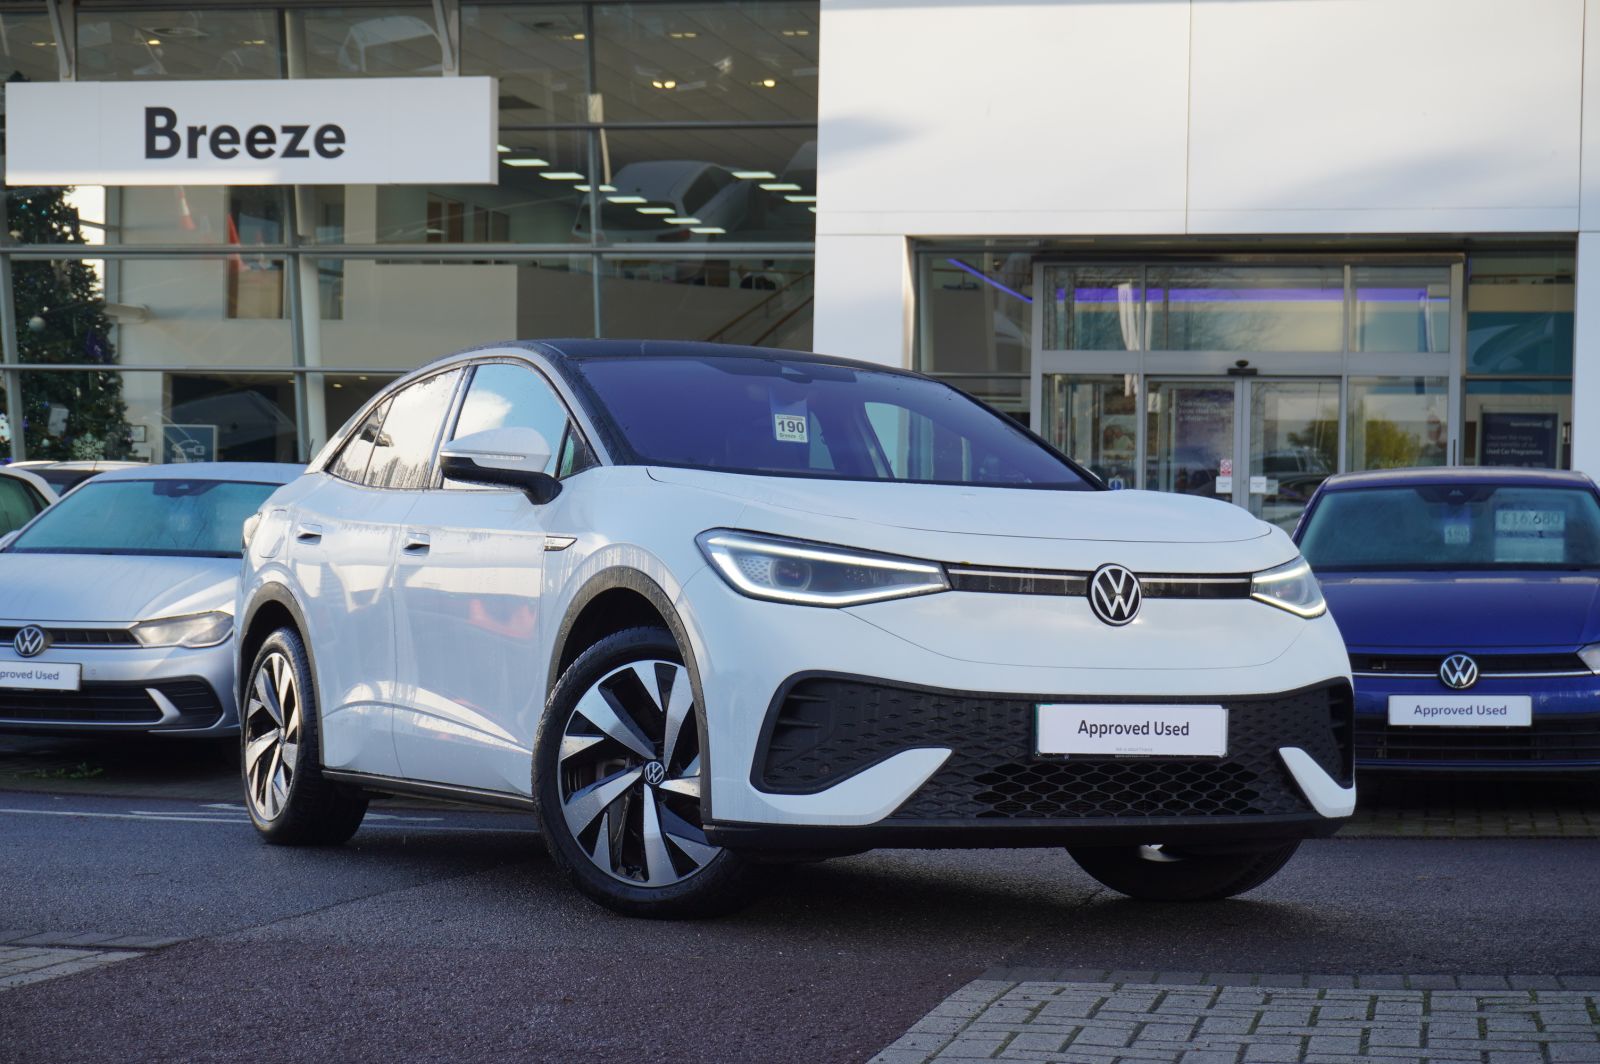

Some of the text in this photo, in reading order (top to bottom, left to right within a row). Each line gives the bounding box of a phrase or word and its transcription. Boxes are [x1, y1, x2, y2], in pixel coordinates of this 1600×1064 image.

[144, 106, 346, 160] Breeze
[778, 420, 805, 434] 190
[35, 670, 59, 680] Used
[1414, 705, 1507, 717] Approved Used
[1077, 720, 1190, 738] Approved Used
